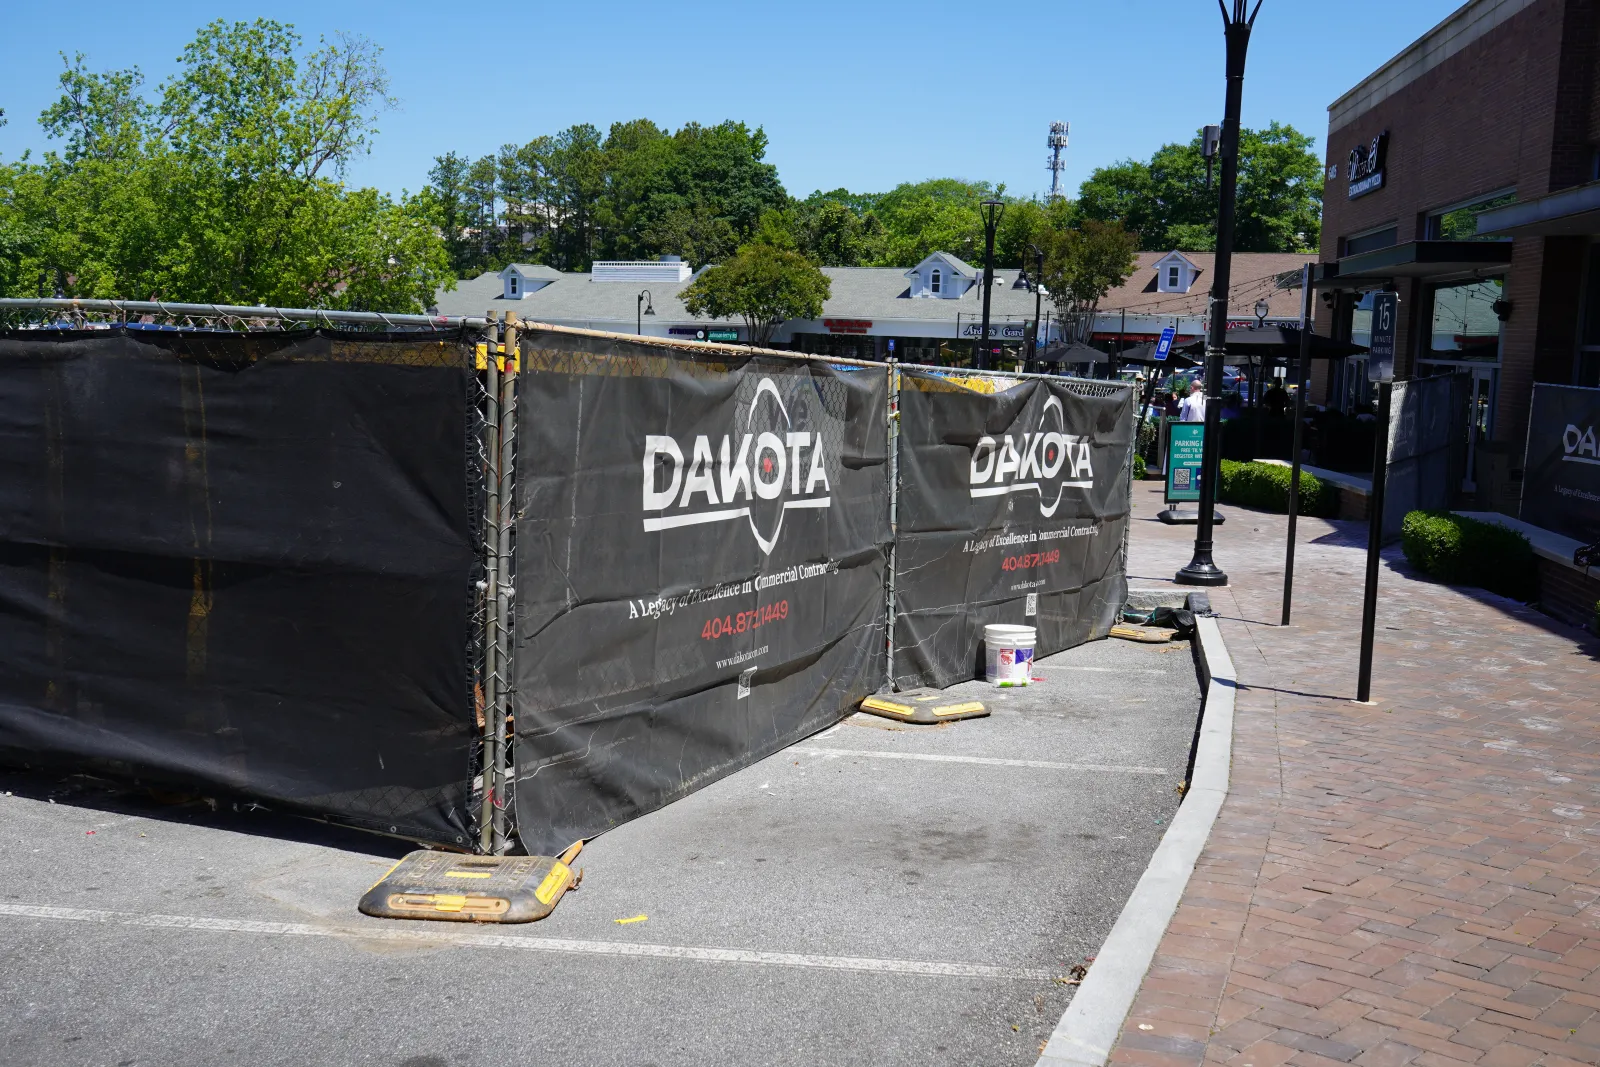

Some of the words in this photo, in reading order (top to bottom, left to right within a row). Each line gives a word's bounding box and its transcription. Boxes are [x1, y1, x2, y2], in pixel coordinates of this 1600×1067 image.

[963, 325, 997, 336] Ardn's
[1002, 326, 1025, 337] Gard
[1378, 302, 1391, 331] 15
[1372, 346, 1392, 355] PARKING
[1374, 335, 1392, 344] MINUTE
[1563, 424, 1600, 458] DA
[642, 431, 830, 511] DAKOTA
[970, 431, 1094, 485] DAKOTA
[962, 541, 968, 553] A
[995, 532, 1029, 547] Excellence
[1029, 530, 1037, 542] in
[628, 600, 638, 619] A
[638, 597, 677, 620] Legacy
[677, 589, 691, 608] of
[690, 582, 738, 605] Excellence
[739, 579, 751, 594] in
